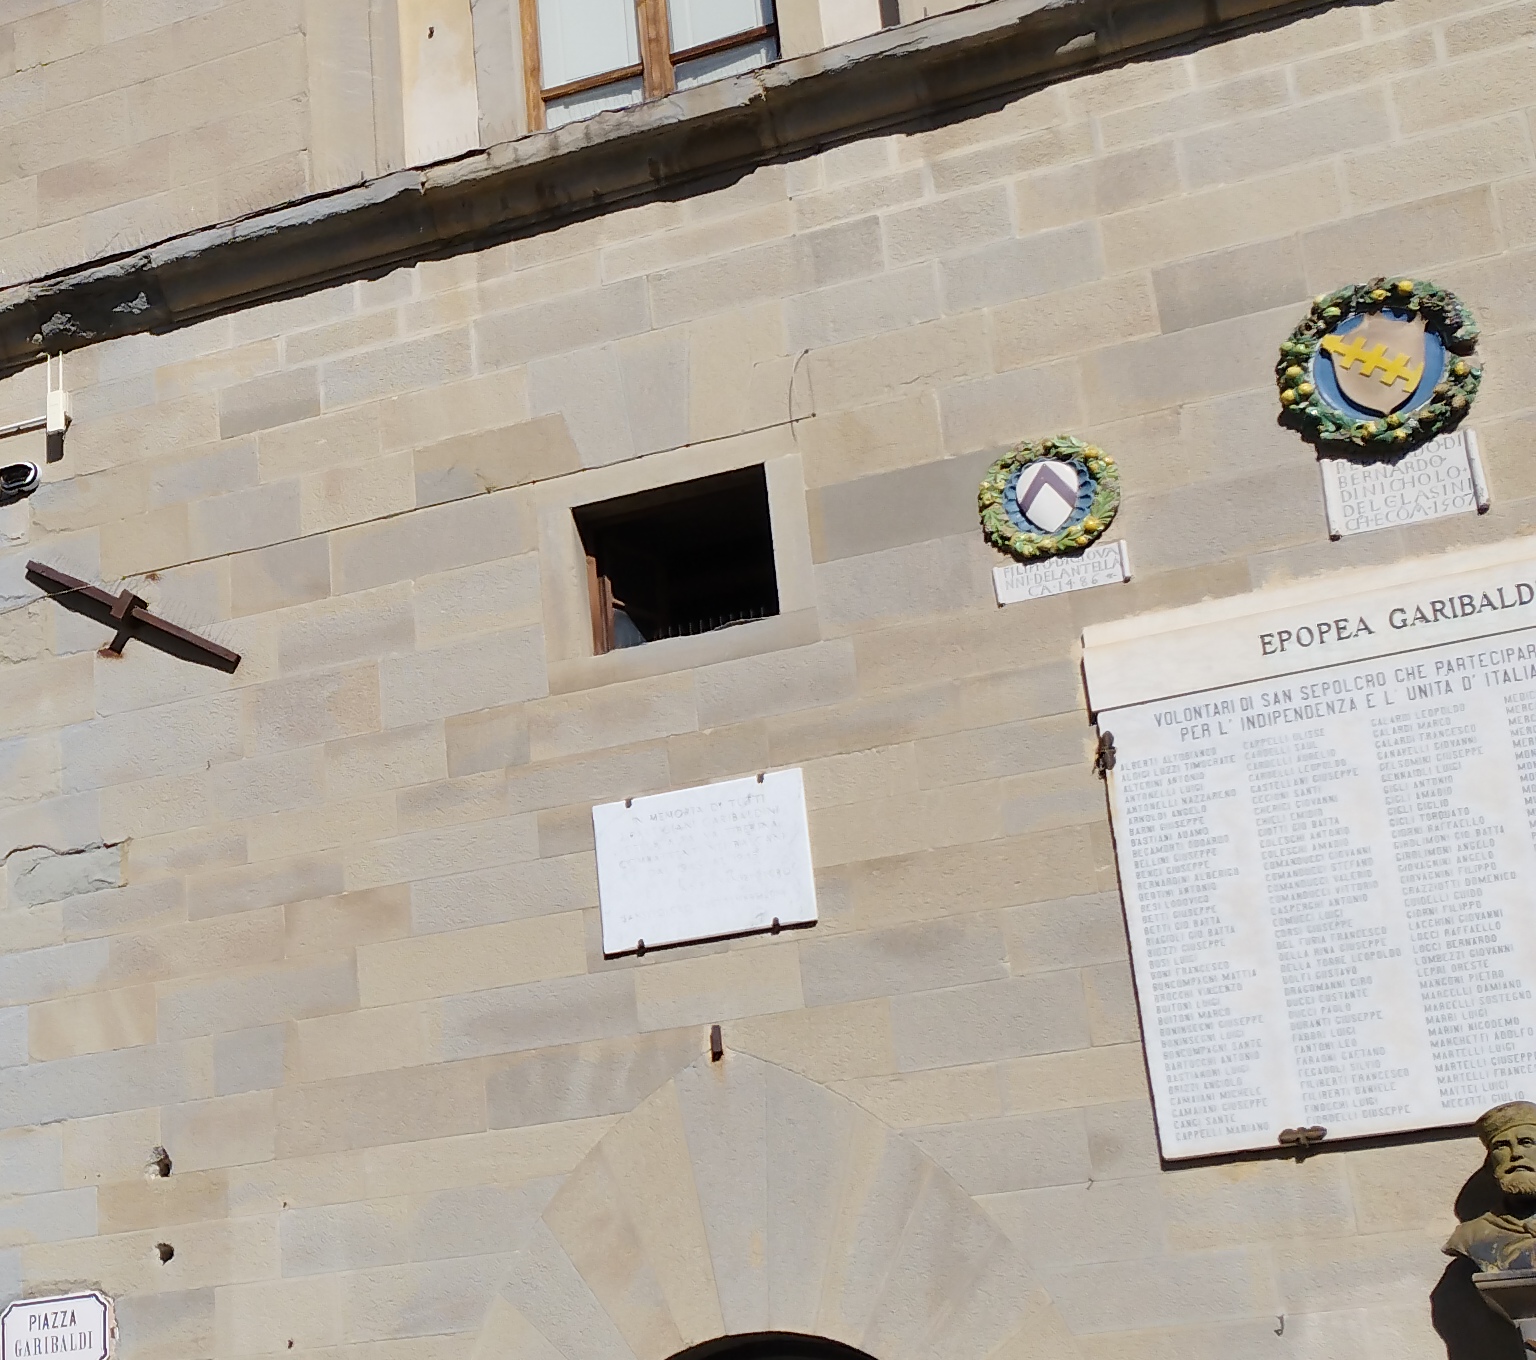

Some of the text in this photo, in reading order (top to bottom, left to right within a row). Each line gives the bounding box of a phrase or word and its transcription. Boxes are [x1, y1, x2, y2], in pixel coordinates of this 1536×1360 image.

[1259, 582, 1536, 656] EPOPEA GARIBALD
[1153, 697, 1236, 729] VOLONTARI
[1237, 694, 1254, 712] DI
[1259, 686, 1293, 708] SAN
[1298, 669, 1387, 702] SEPOLCRO
[1393, 662, 1427, 684] CHE
[1179, 722, 1211, 743] PER
[1239, 694, 1357, 732] INDIPENDENZA
[1364, 691, 1376, 709] E
[14, 1331, 93, 1358] GARIBALDI
[29, 1309, 77, 1331] PIAZZA
